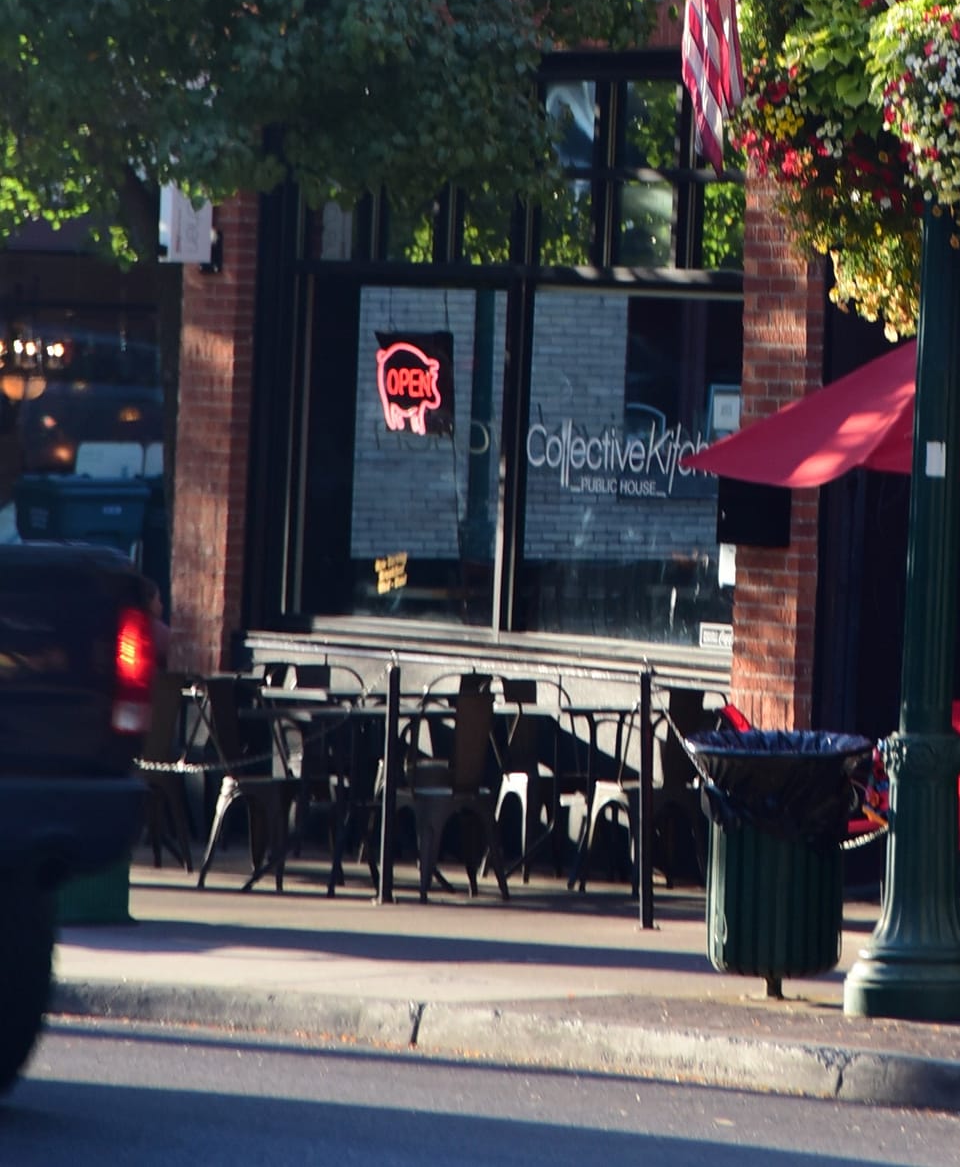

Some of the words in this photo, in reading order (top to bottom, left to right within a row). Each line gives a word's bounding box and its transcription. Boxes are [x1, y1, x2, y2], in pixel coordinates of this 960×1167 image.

[387, 367, 432, 397] OPEN
[581, 477, 618, 493] PUBLIC
[620, 481, 656, 496] HOUSE
